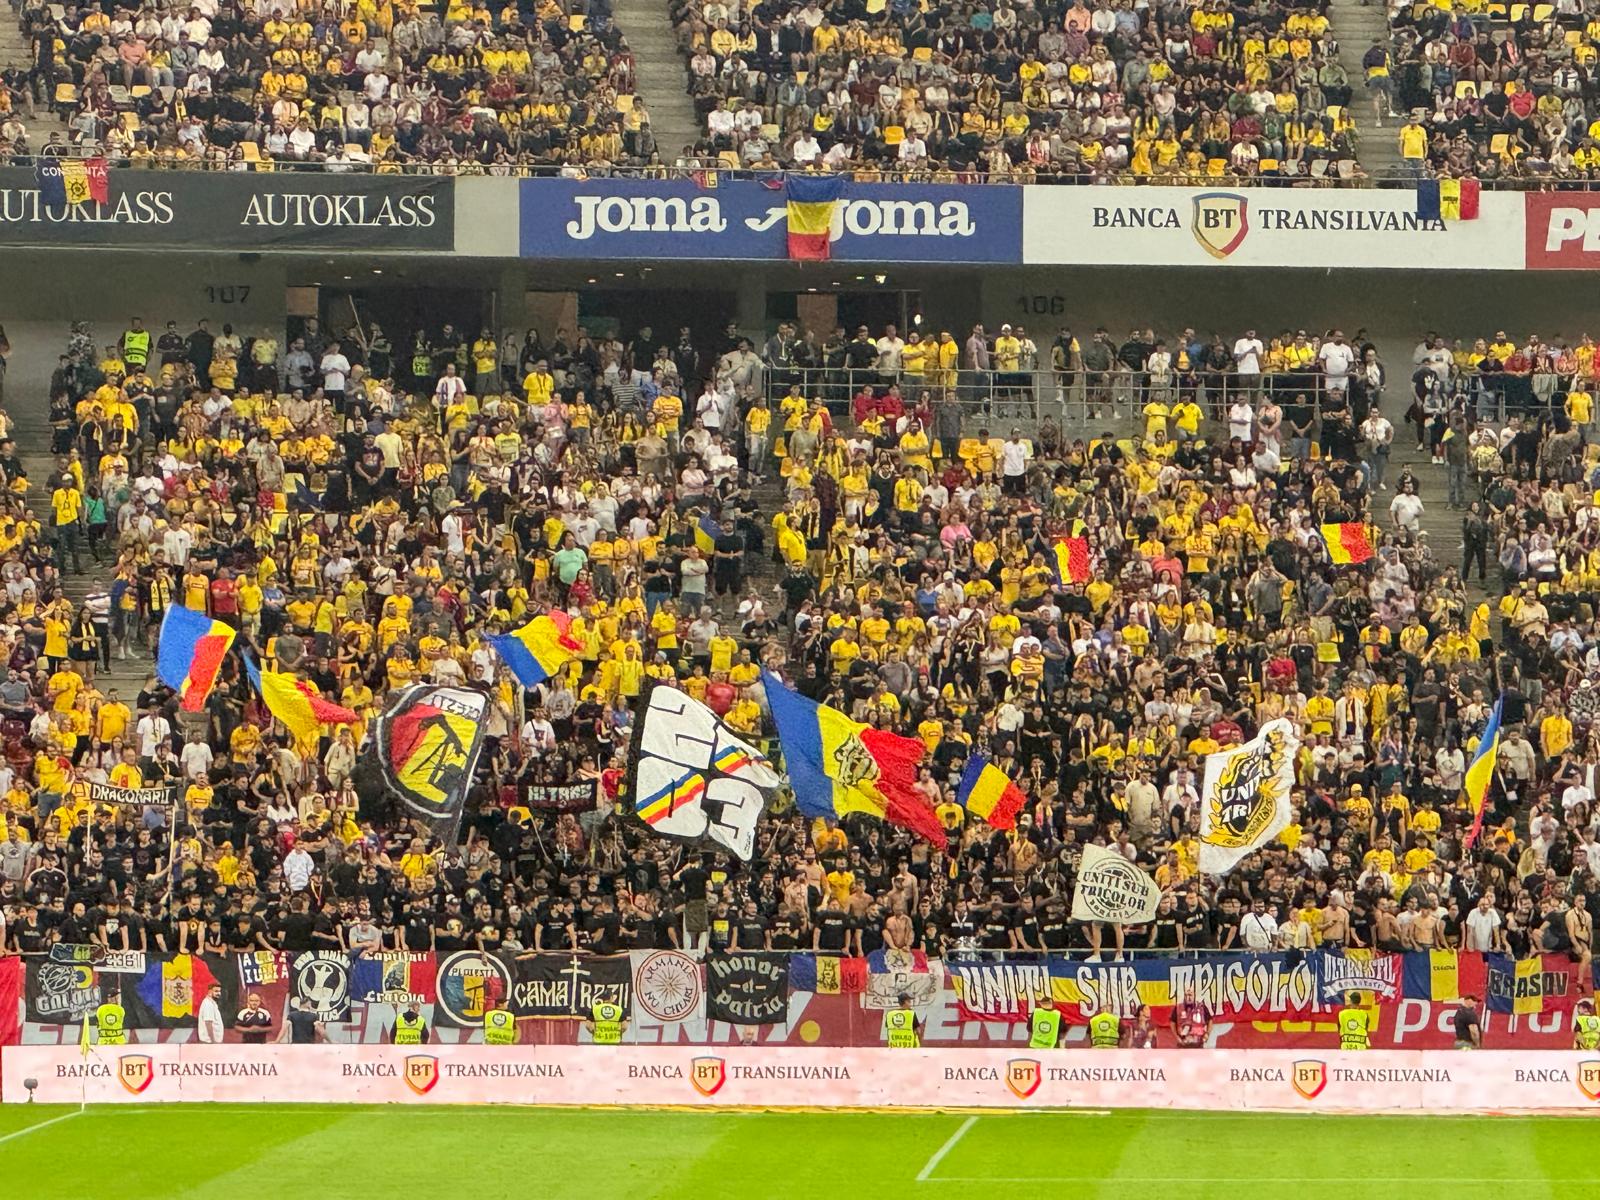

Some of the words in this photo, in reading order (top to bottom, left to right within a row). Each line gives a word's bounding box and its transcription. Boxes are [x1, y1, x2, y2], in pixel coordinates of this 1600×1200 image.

[240, 194, 435, 227] AUTOKLASS
[1092, 207, 1181, 229] BANCA
[1203, 208, 1236, 228] BT
[204, 285, 250, 304] 107
[1017, 295, 1065, 316] 106
[1122, 880, 1149, 897] SUB
[1080, 884, 1147, 911] TRICOLOR
[243, 951, 289, 967] ALBA
[244, 963, 289, 985] IULIA
[1490, 968, 1569, 999] BRASOV
[56, 1064, 112, 1077] BANCA
[125, 1063, 146, 1076] BT
[160, 1063, 278, 1077] TRANSILVANIA
[342, 1063, 397, 1077] BANCA
[411, 1063, 433, 1077] BT
[445, 1064, 564, 1078] TRANSILVANIA
[628, 1065, 683, 1078] BANCA
[697, 1065, 718, 1079] BT
[731, 1066, 851, 1079] TRANSILVANIA
[944, 1067, 999, 1080] BANCA
[1013, 1067, 1034, 1080] BT
[1048, 1068, 1166, 1081] TRANSILVANIA
[1230, 1068, 1285, 1082] BANCA
[1299, 1069, 1320, 1082] BT
[1333, 1069, 1452, 1082] TRANSILVANIA
[1514, 1069, 1570, 1082] BANCA
